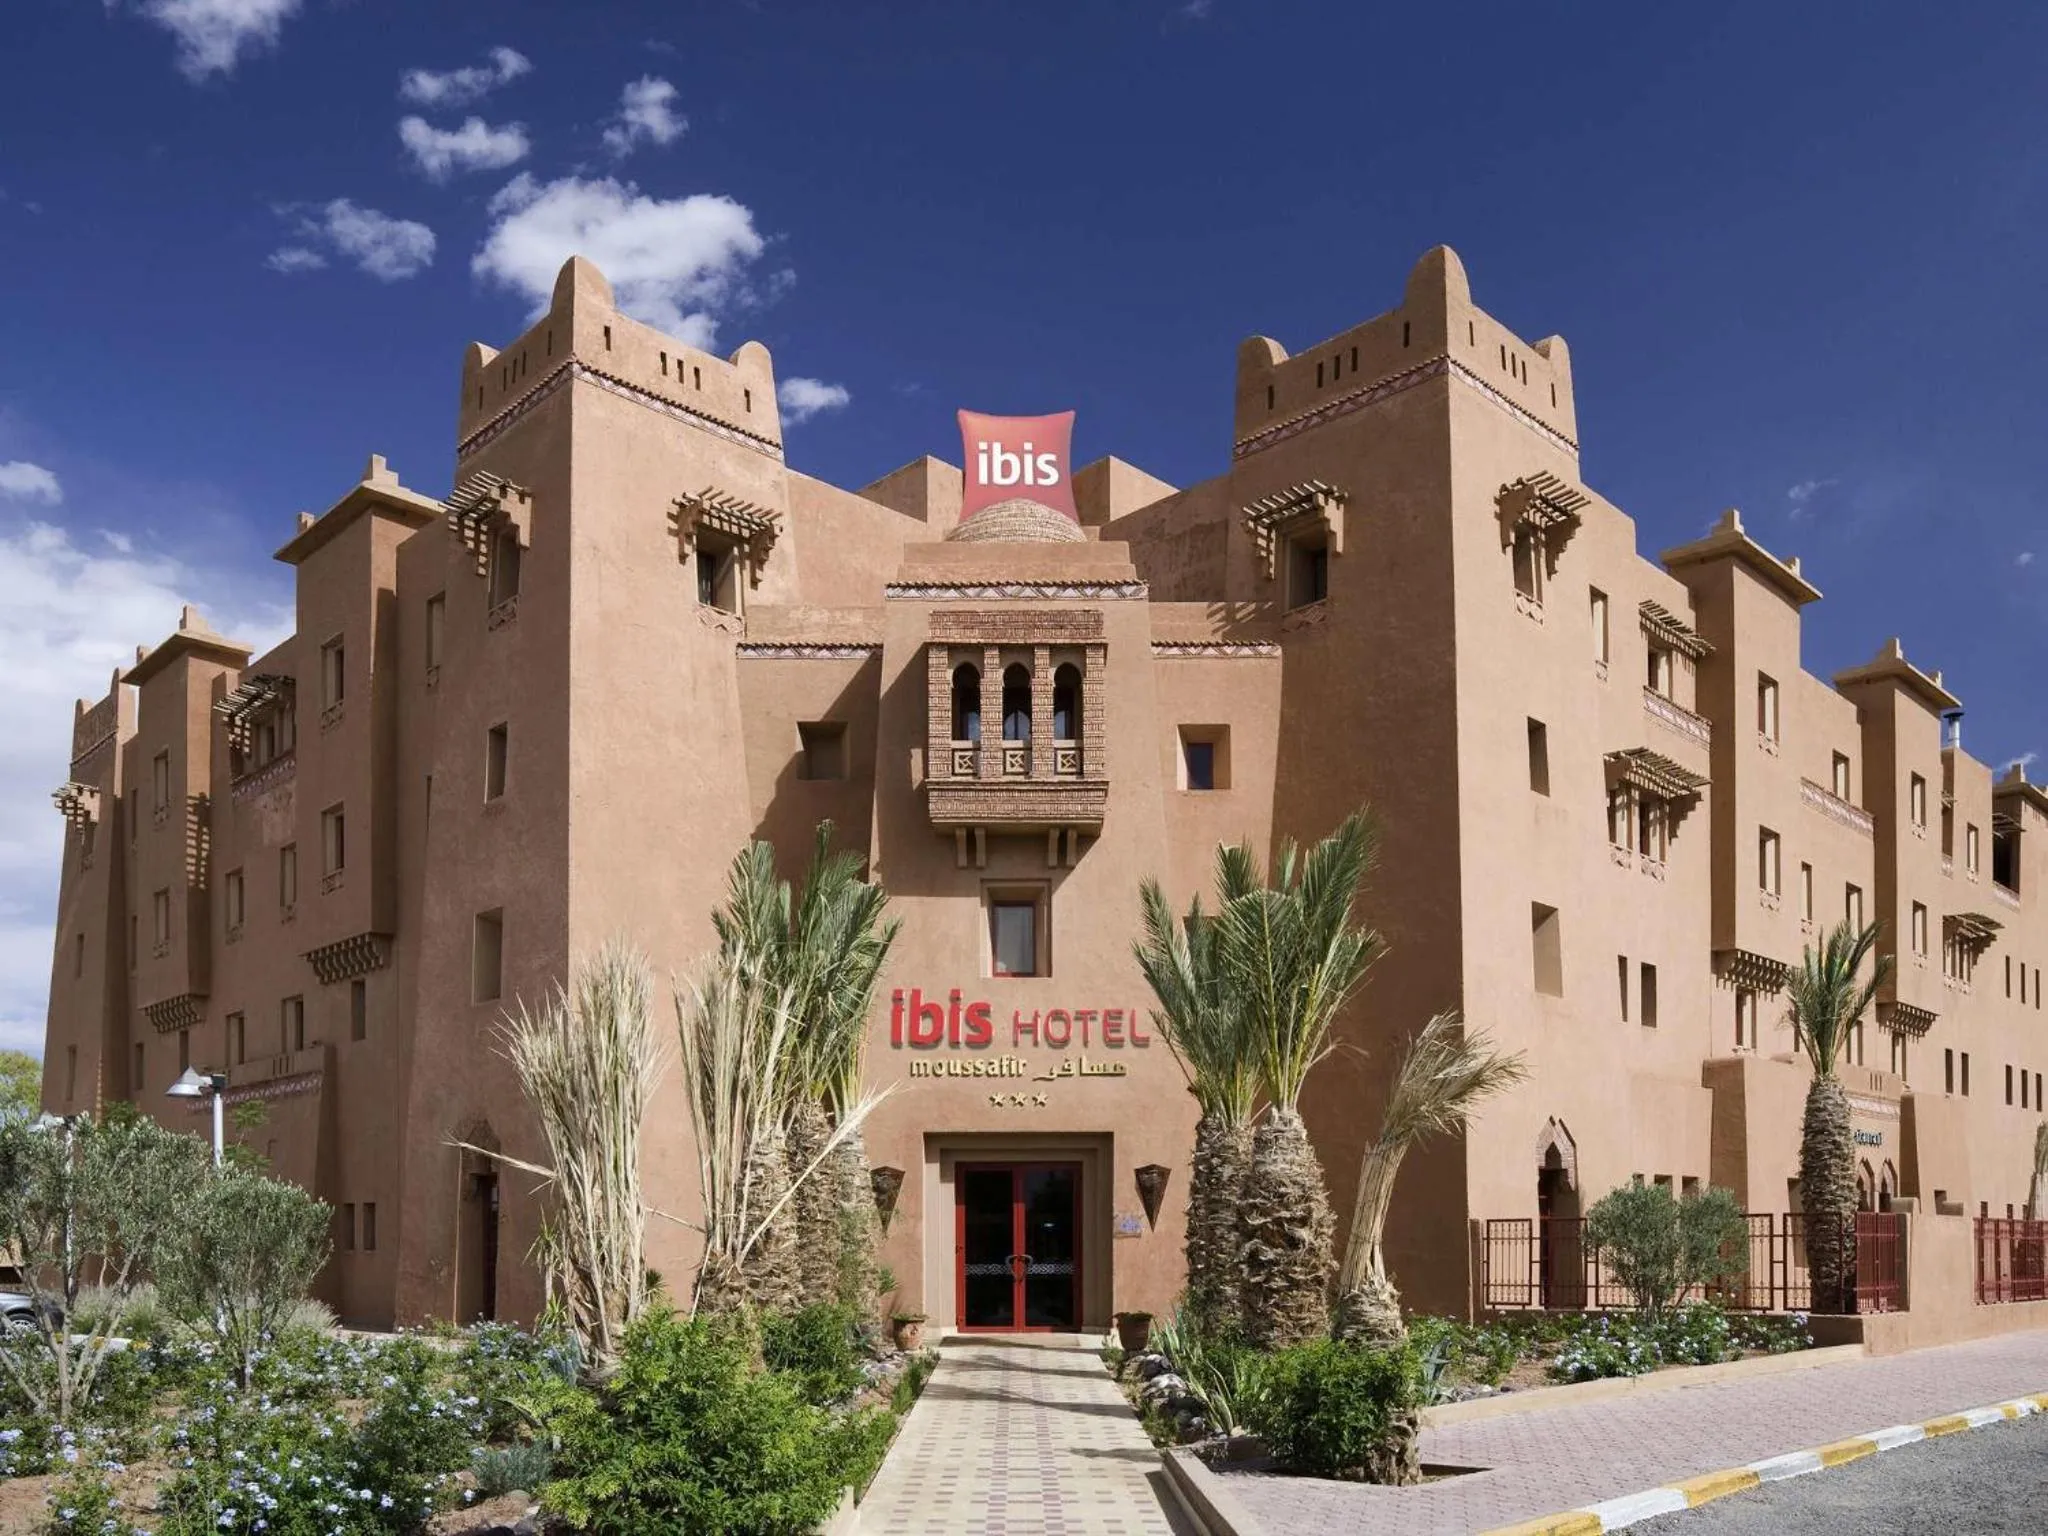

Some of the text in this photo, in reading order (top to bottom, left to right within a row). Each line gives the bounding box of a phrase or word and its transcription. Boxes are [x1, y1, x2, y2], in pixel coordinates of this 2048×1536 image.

[978, 441, 1059, 486] ibis
[890, 988, 1151, 1047] ibis HOTEL
[909, 1055, 1027, 1077] moussafir
[1032, 1055, 1128, 1082] مسافر
